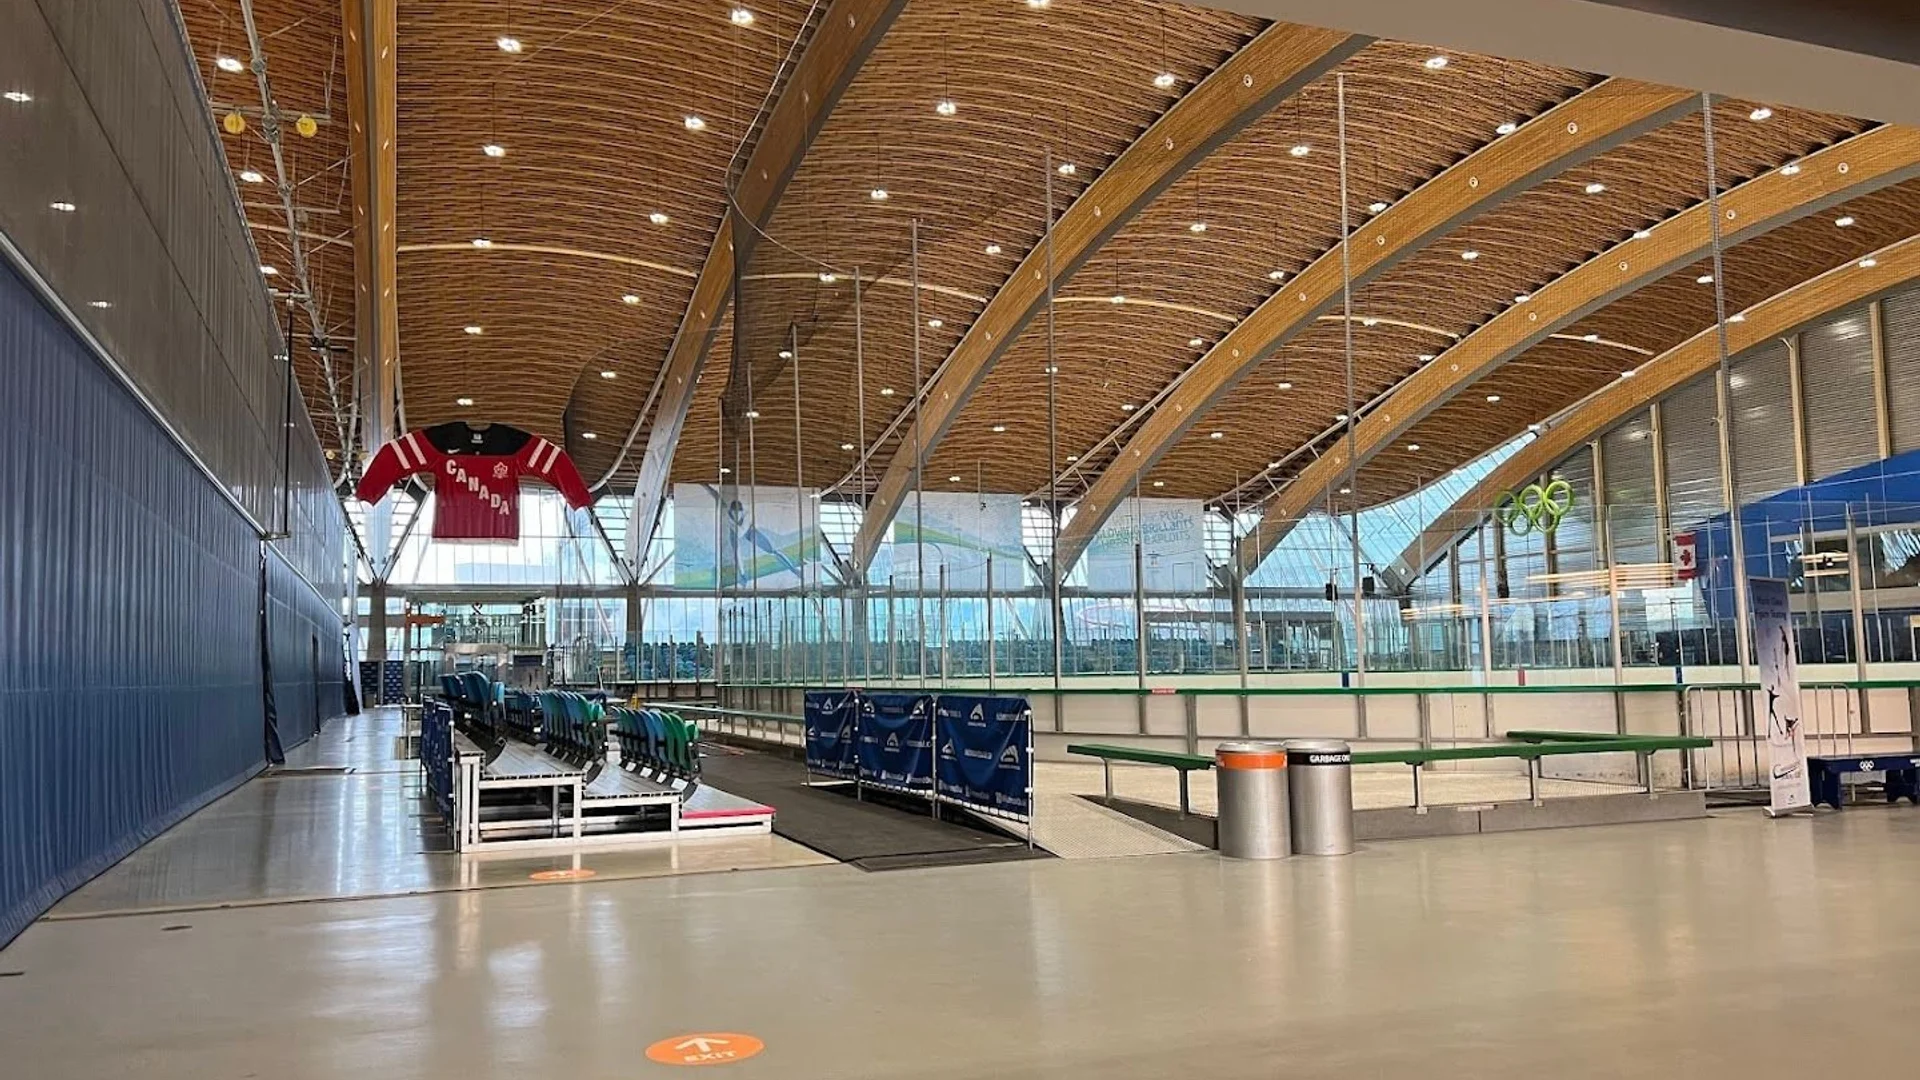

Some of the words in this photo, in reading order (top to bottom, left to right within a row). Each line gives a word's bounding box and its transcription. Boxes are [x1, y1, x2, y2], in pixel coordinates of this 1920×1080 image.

[446, 459, 510, 515] CANADA
[1309, 754, 1342, 763] GARBAGE
[684, 1051, 737, 1062] EXIT
